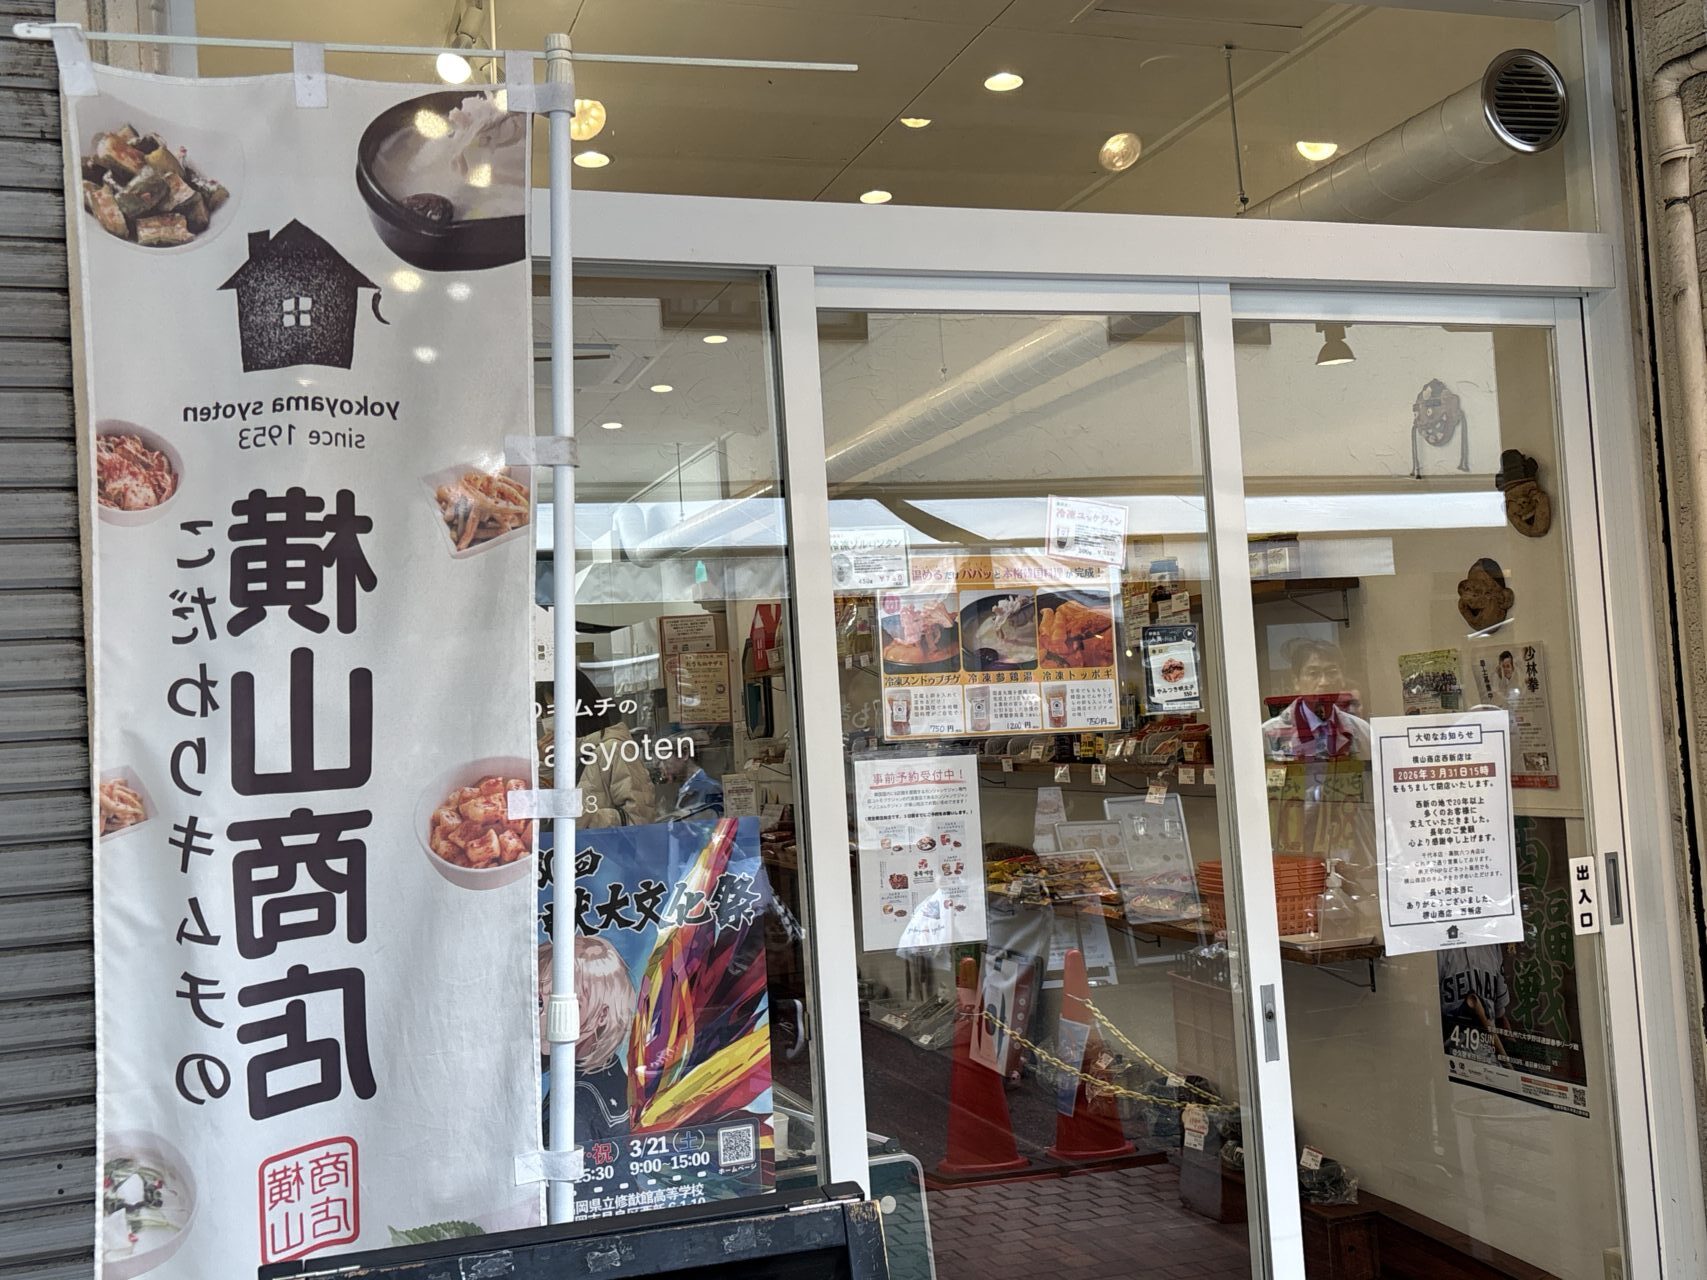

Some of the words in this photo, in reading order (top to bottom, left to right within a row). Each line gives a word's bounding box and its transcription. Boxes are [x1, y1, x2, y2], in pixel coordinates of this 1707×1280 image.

[1042, 669, 1112, 682] 冷凍トッポギ
[1523, 645, 1540, 693] 少林拳
[1415, 730, 1474, 742] 大切なお知らせ
[579, 733, 695, 771] syoten
[1412, 752, 1472, 764] 横山商店西新店は
[873, 768, 963, 785] 事前予約受付中！
[1393, 779, 1493, 793] をもちまして閉店いたします。
[1415, 797, 1484, 808] 西新の地で20年以上
[1424, 806, 1477, 818] 多くのお客様に
[1409, 816, 1490, 828] 支えていただきました。
[1430, 825, 1475, 837] 長年のご愛顧
[1408, 834, 1495, 847] 心より感謝申し上げます。
[1429, 885, 1474, 897] 長い間本当に
[1576, 864, 1593, 928] 出入口
[1422, 908, 1453, 919] 横山商店
[1450, 1024, 1480, 1051] 4.19
[629, 1136, 669, 1158] 3/21
[718, 1162, 758, 1175] ホームページ
[573, 1182, 705, 1216] 岡県立修猷館高等学校
